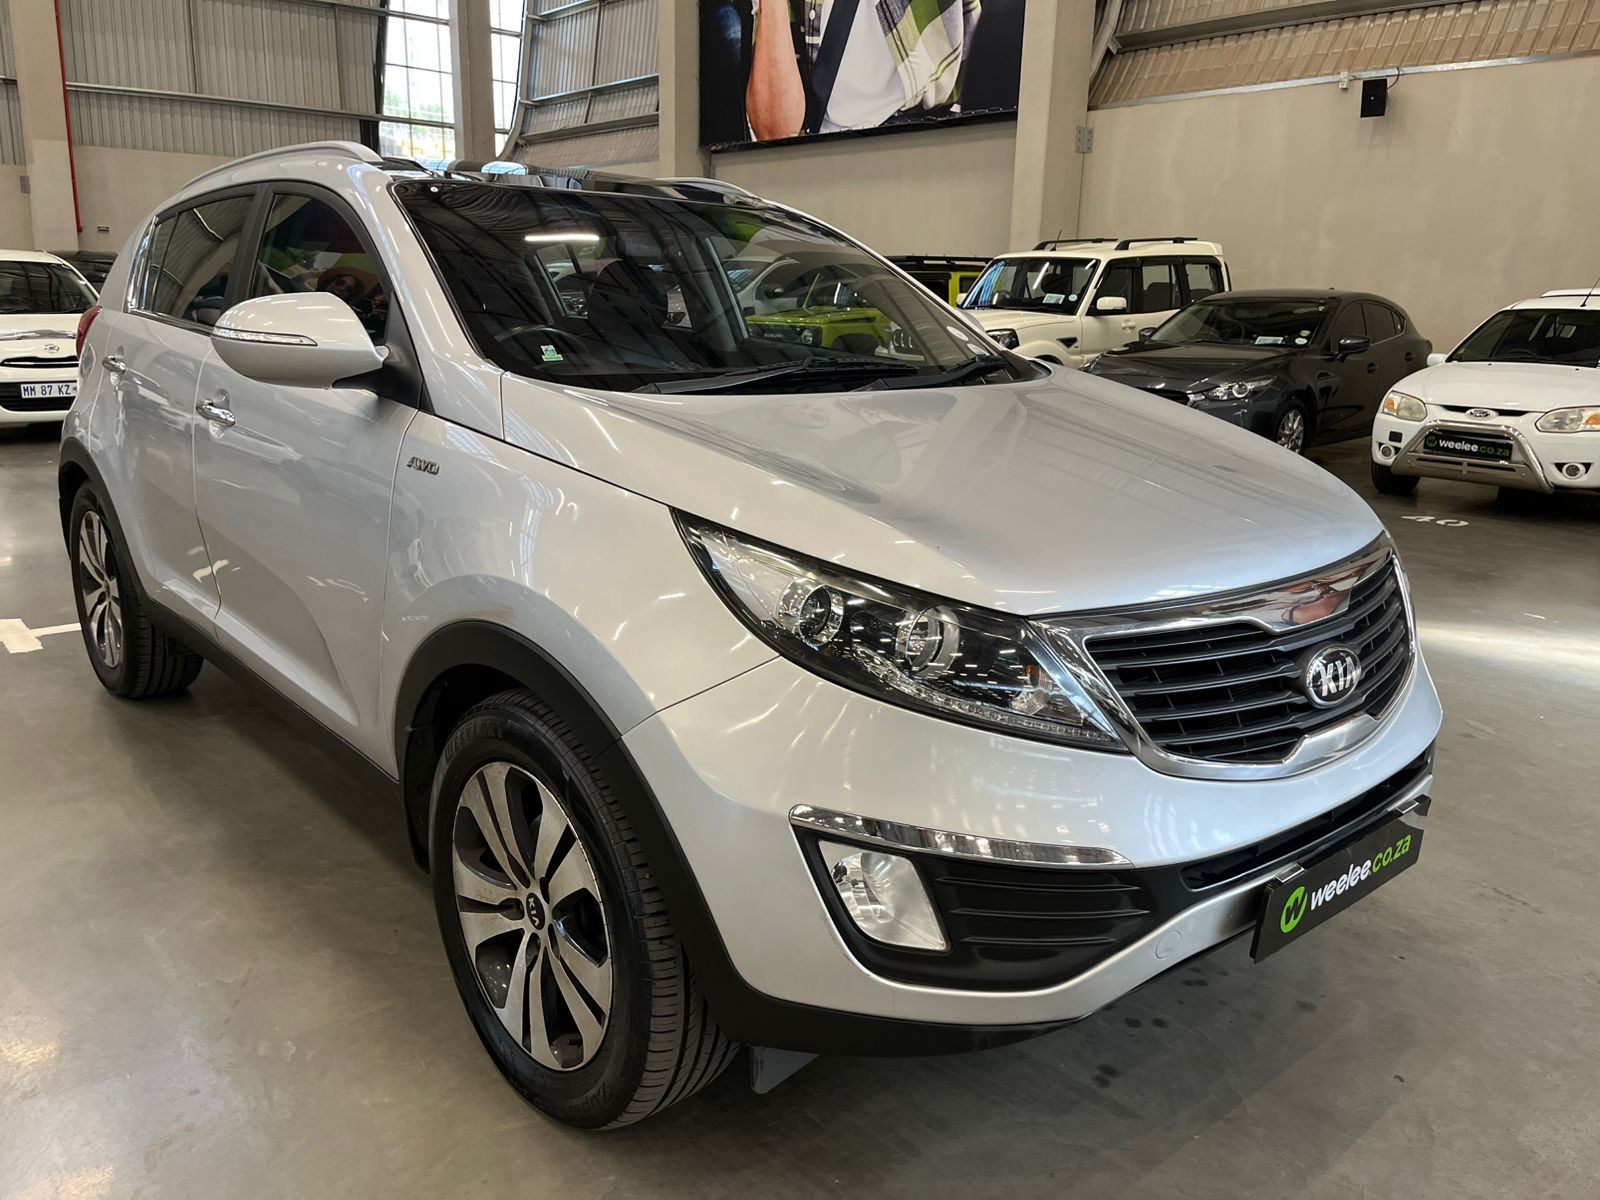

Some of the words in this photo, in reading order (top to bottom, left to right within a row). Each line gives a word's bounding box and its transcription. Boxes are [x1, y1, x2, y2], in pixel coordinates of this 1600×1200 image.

[41, 384, 53, 396] 87
[57, 384, 71, 396] KZ
[1438, 438, 1511, 457] weelee.co.za
[406, 456, 440, 476] AWD
[1319, 656, 1358, 697] KIA
[1310, 834, 1413, 911] weelee.co.za
[528, 897, 540, 927] KIA
